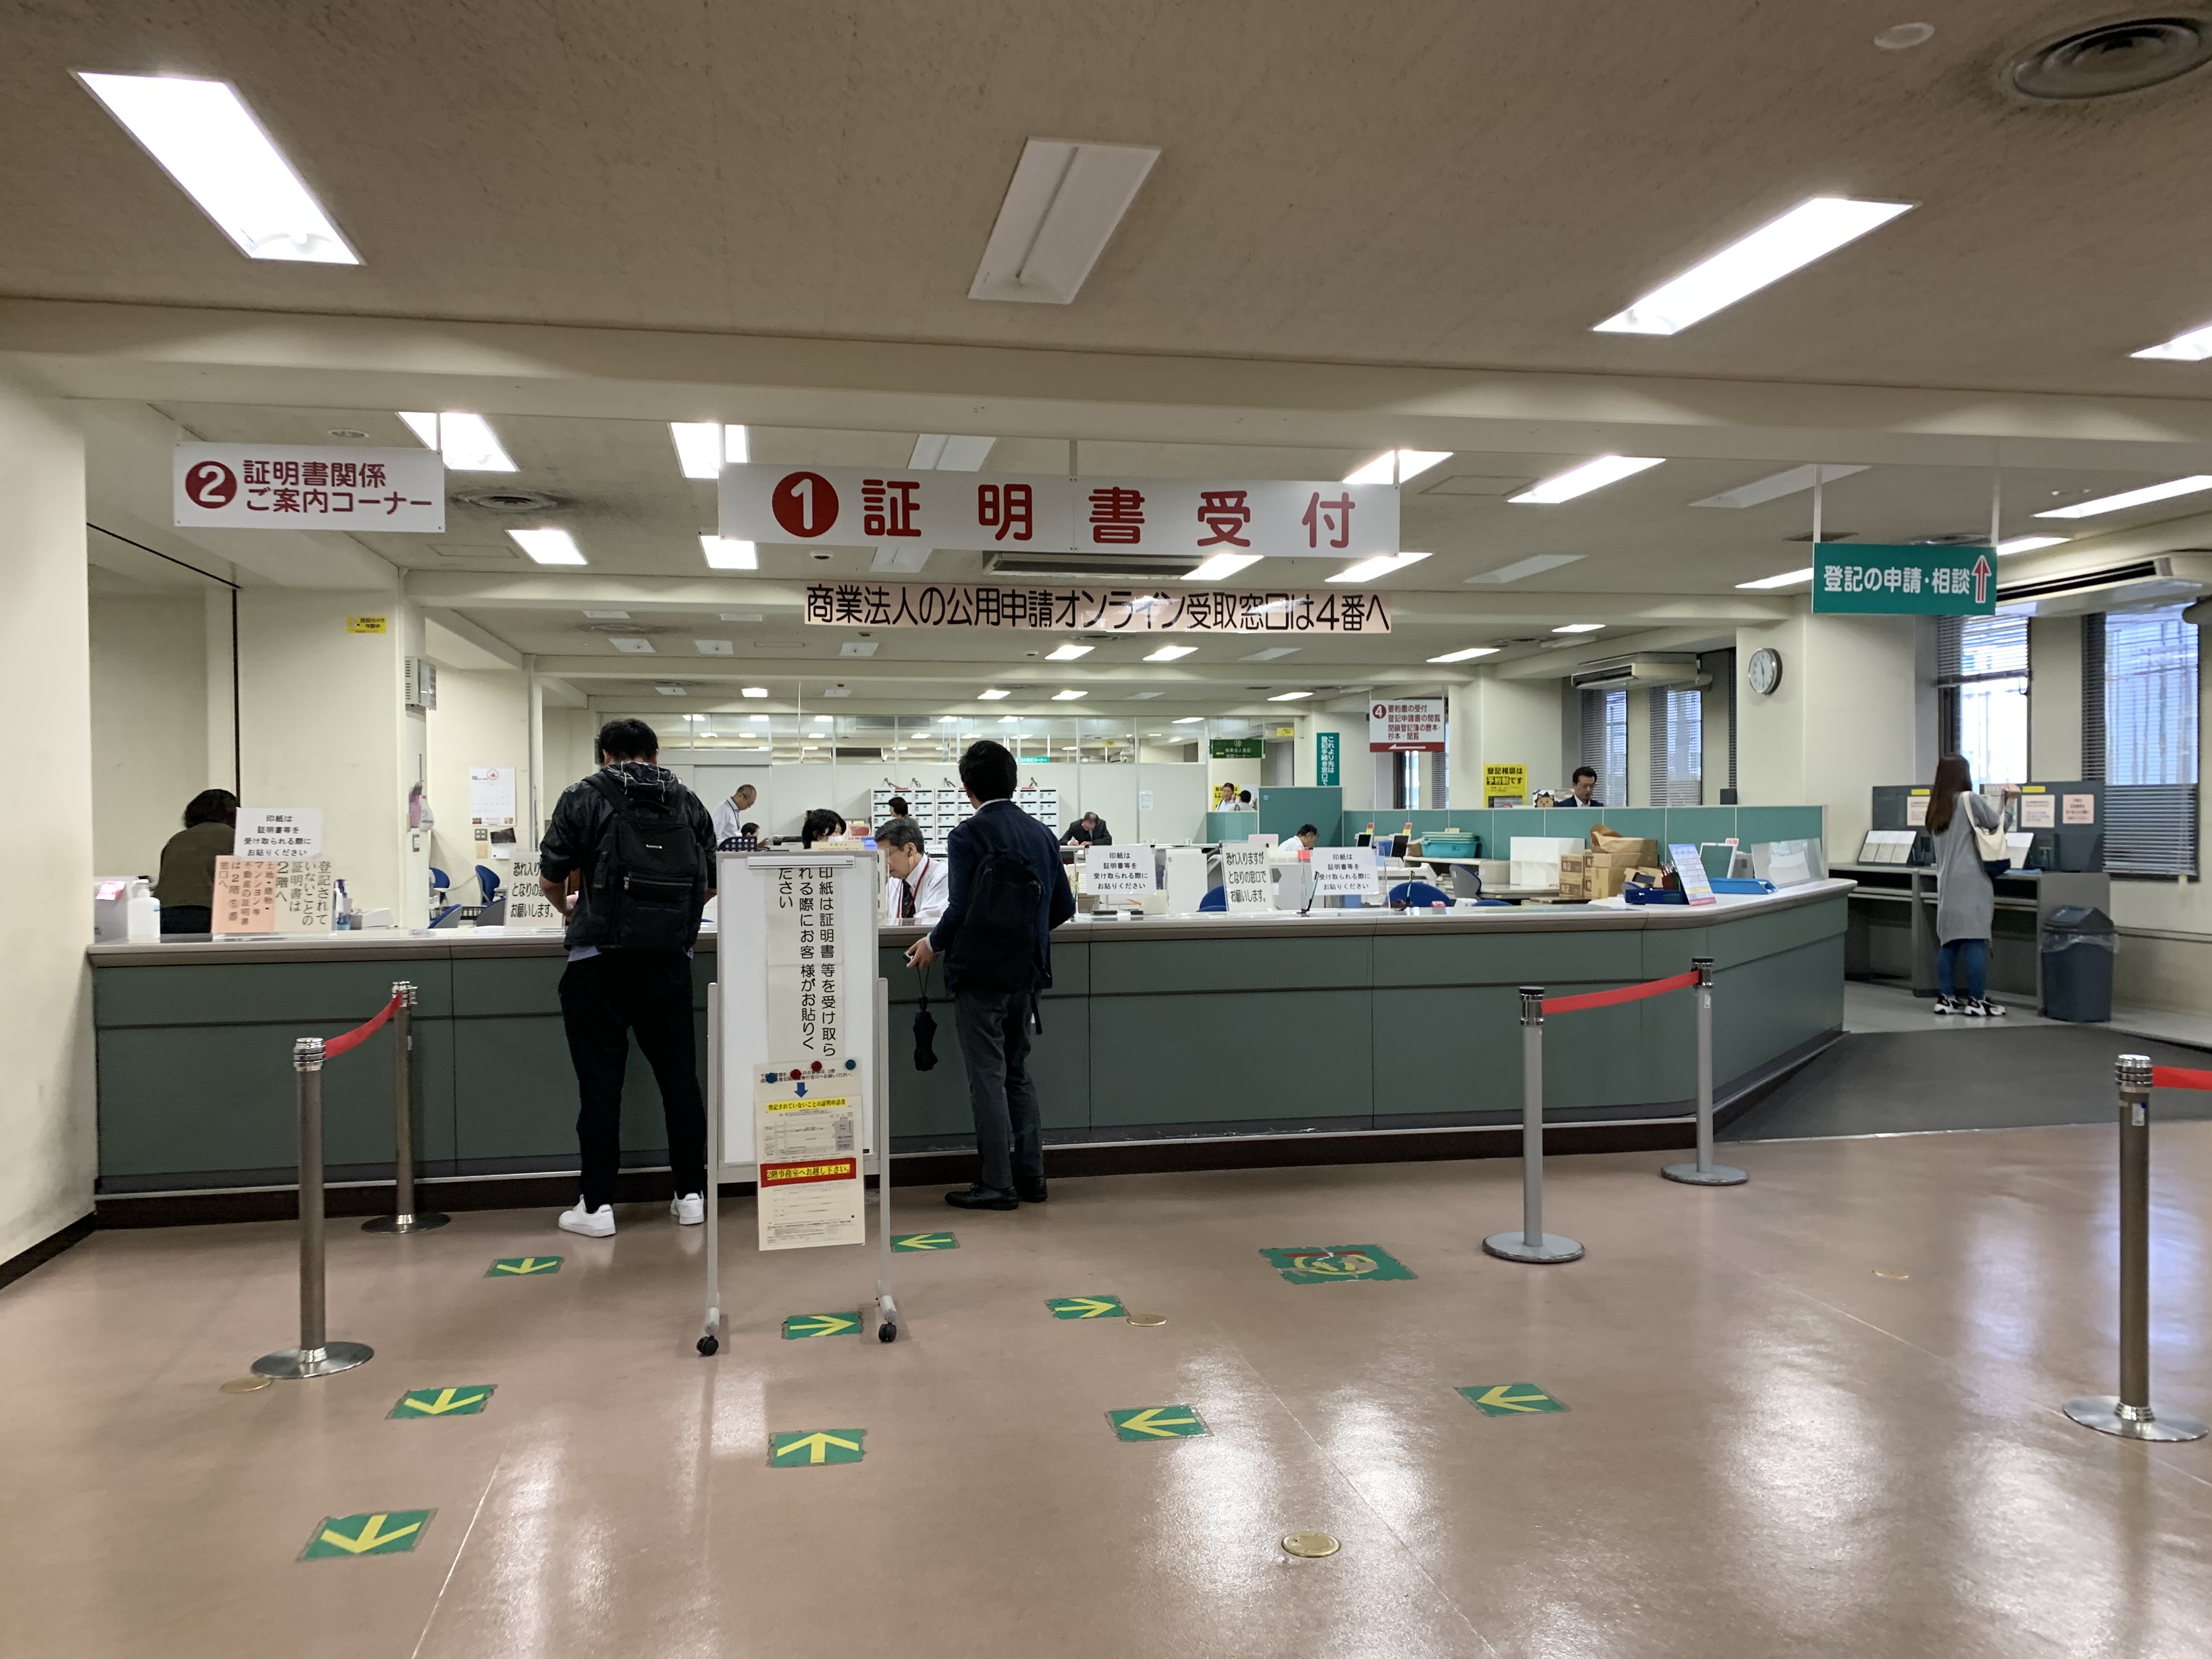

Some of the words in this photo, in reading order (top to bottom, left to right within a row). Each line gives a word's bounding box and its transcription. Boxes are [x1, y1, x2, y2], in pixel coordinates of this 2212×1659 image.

[198, 464, 227, 503] 2
[243, 459, 387, 489] 証明書関係
[246, 488, 432, 515] ご案内コーナー
[861, 478, 1356, 549] 証明書受付
[1823, 565, 1971, 595] 登記の申請・相談
[806, 583, 1390, 631] 商業法人の公用申請オンライン受取窓口は4番へ
[1387, 704, 1427, 713] 要約書の受付
[1388, 714, 1441, 723] 登記申請書の閲覧
[1388, 732, 1420, 741] 抄本・閲覧
[1486, 776, 1523, 785] 予約制です
[244, 837, 312, 845] 受け取られる際に
[257, 826, 300, 834] 証明書等を
[1226, 851, 1265, 866] 恐れ入りますが
[276, 861, 289, 902] 2階へ
[289, 861, 303, 912] 証明書は
[1229, 871, 1266, 884] となりの窓口で
[302, 861, 317, 926] いないことの
[317, 861, 332, 925] 登記されて
[1230, 889, 1266, 903] お願いします。
[510, 902, 554, 918] お願いします。
[799, 867, 816, 1050] れる際にお客様がお貼りく
[819, 867, 836, 1057] 印紙は証明書等を受け取ら
